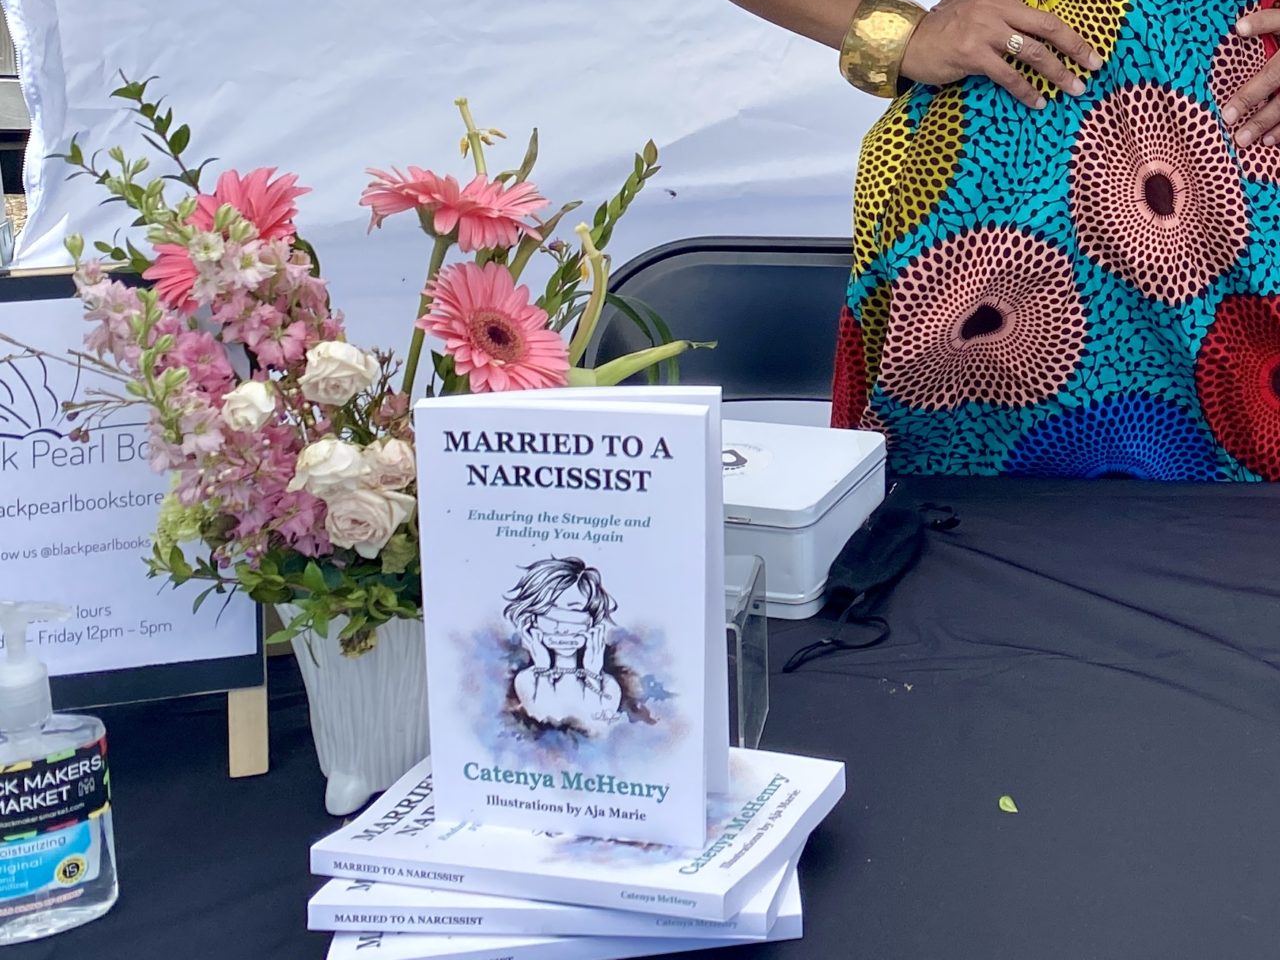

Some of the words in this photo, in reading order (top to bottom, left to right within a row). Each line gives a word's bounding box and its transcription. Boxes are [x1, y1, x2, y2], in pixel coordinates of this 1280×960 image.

[33, 433, 105, 469] Pearl
[443, 430, 594, 456] MARRIED
[602, 434, 644, 459] TO
[650, 437, 673, 460] A
[466, 464, 652, 492] NARCISSIST
[467, 509, 534, 524] Enduring
[537, 511, 559, 524] the
[561, 512, 621, 529] Struggle
[624, 516, 651, 528] and
[495, 525, 550, 541] Finding
[554, 528, 579, 540] You
[582, 530, 624, 544] Again
[23, 548, 37, 559] us
[38, 627, 83, 645] Friday
[86, 625, 124, 642] 12pm
[140, 619, 173, 637] 5pm
[24, 754, 102, 792] MAKERS
[463, 762, 555, 791] Catenya
[561, 771, 670, 804] McHenry
[350, 773, 433, 842] MARRIE
[486, 794, 563, 814] Illustrations
[566, 802, 582, 817] by
[584, 805, 605, 819] Aja
[609, 807, 647, 821] Marie
[679, 833, 738, 875] Catenya
[725, 773, 790, 831] McHenry
[333, 861, 380, 874] MARRIED
[383, 867, 396, 876] TO
[397, 868, 404, 877] A
[407, 870, 465, 883] NARCISSIST
[620, 891, 655, 902] Catenya
[657, 894, 697, 908] McHenry
[334, 913, 388, 923] MARRIED
[390, 915, 405, 924] TO
[407, 916, 416, 924] A
[418, 916, 484, 926] NARCISSIST
[656, 918, 693, 930] Catenya
